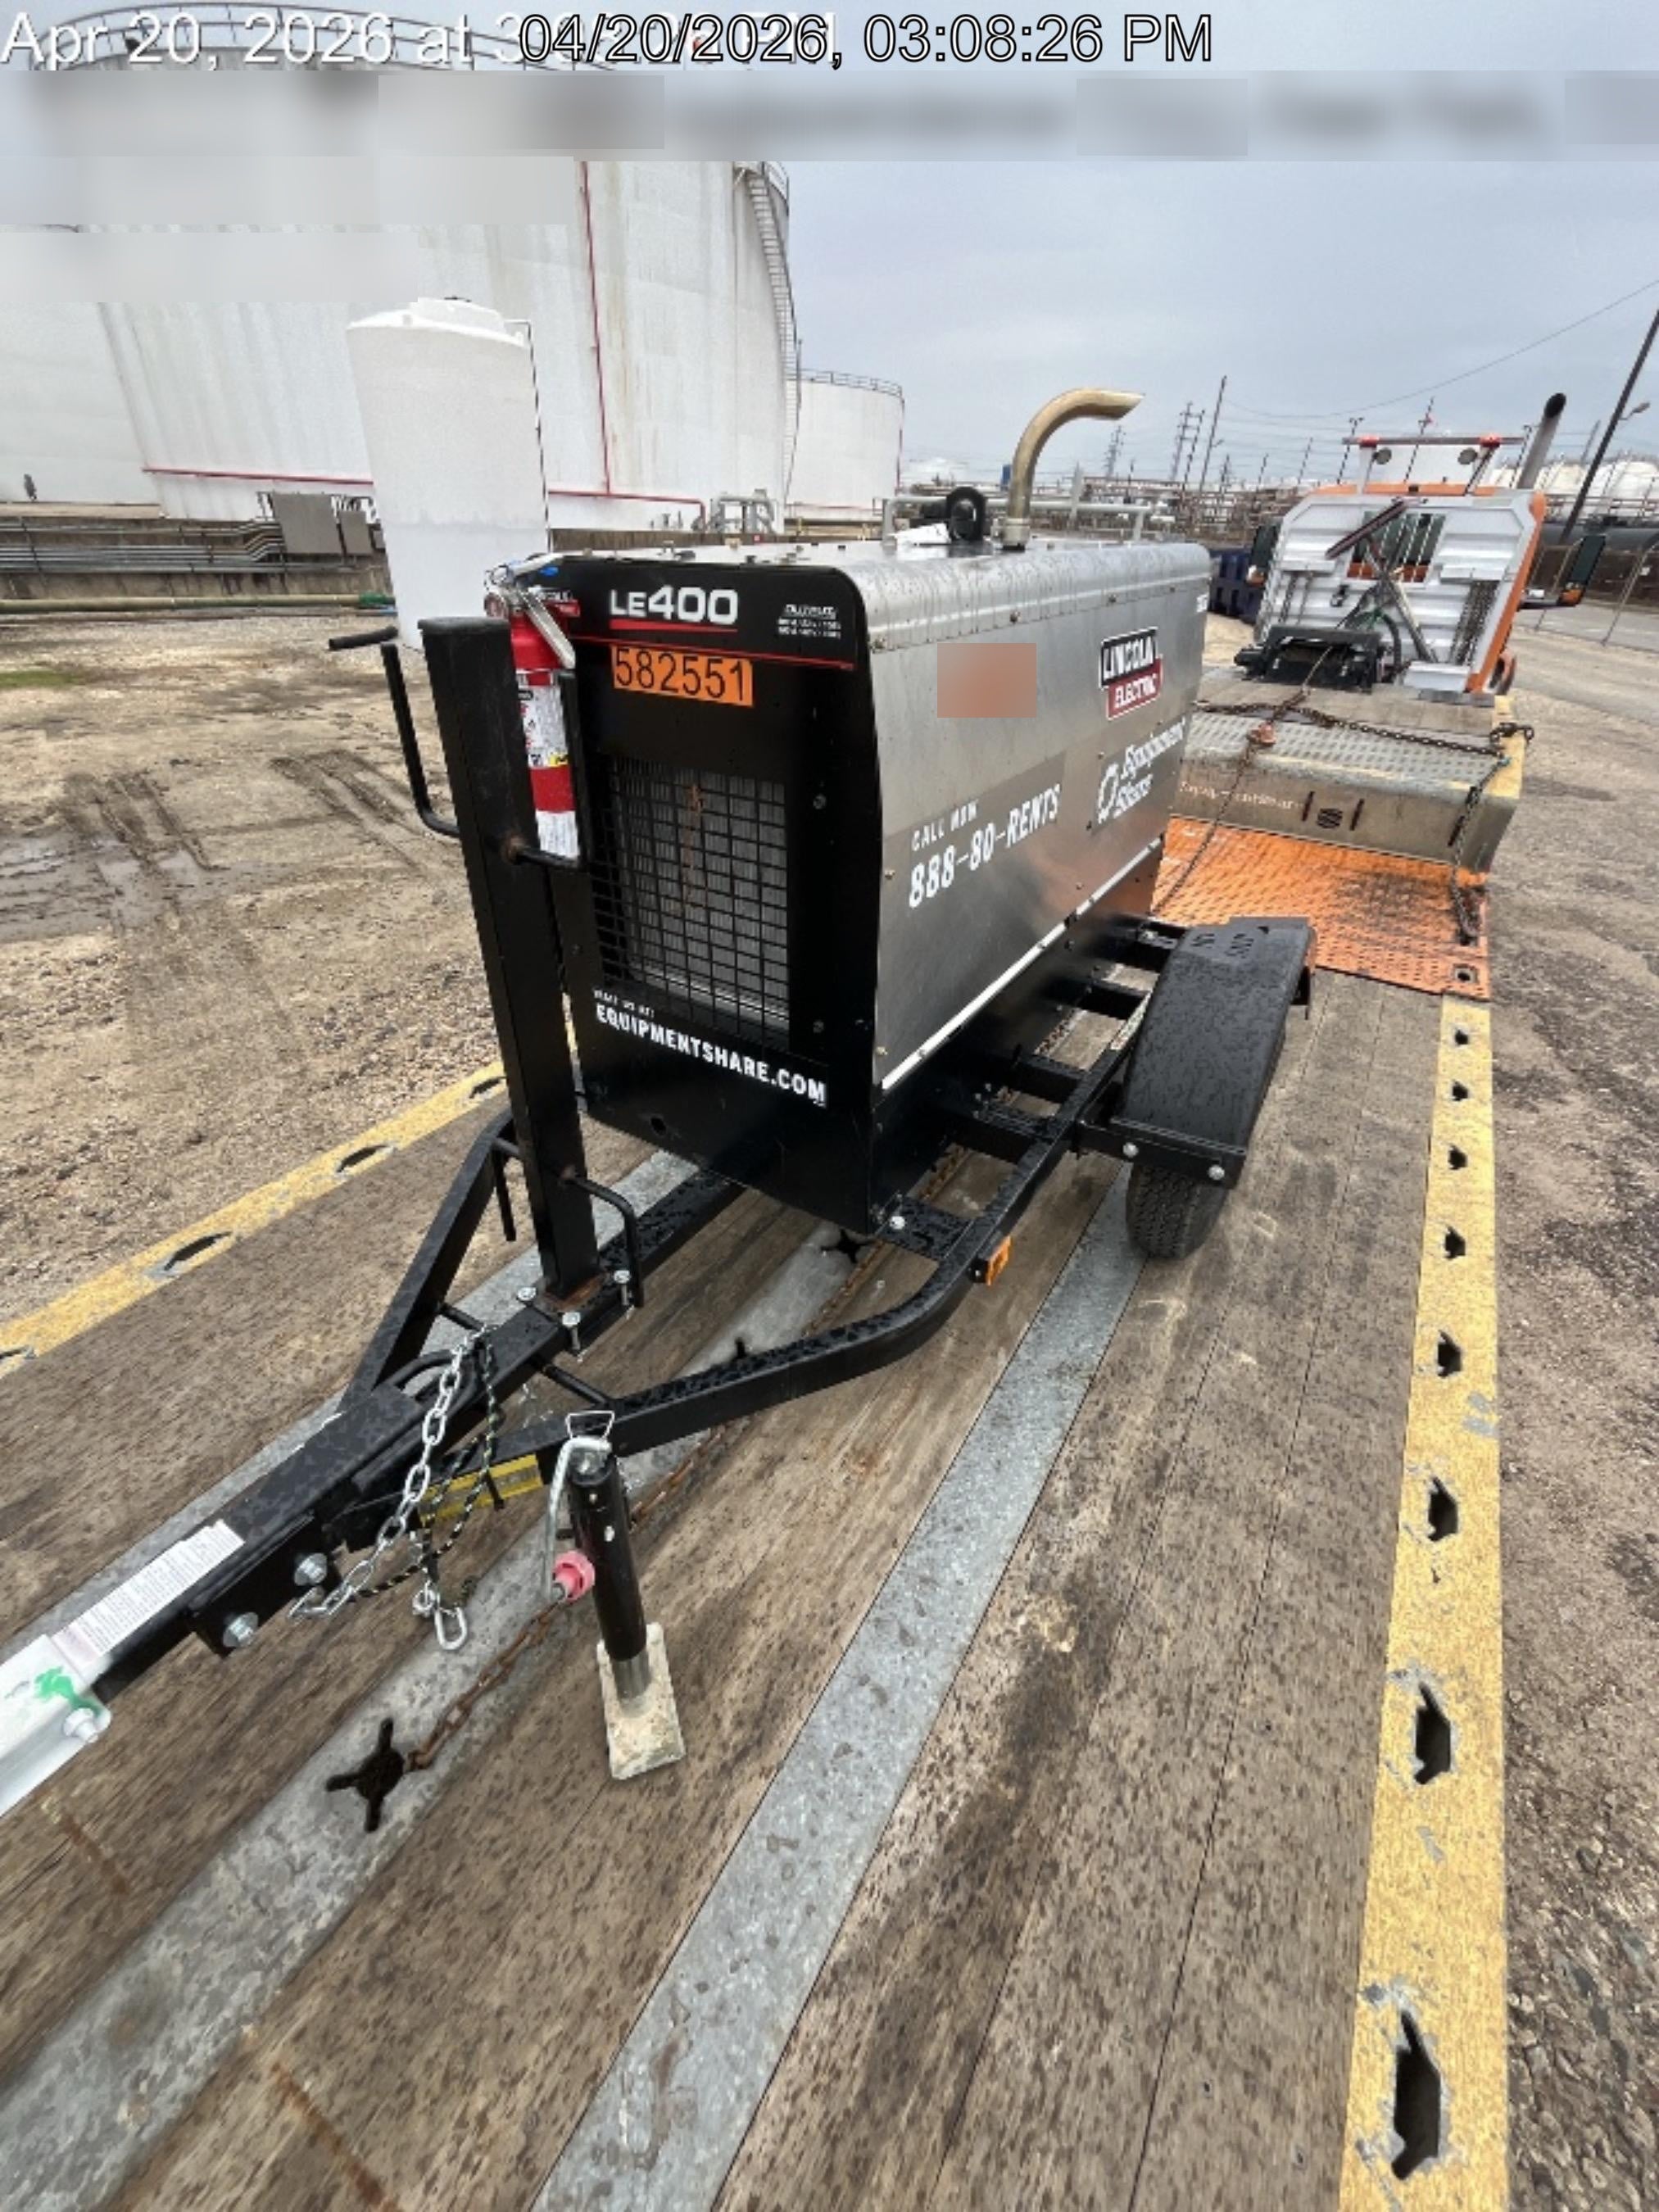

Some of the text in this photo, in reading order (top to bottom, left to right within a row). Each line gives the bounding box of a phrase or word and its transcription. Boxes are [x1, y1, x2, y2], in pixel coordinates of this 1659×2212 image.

[610, 585, 739, 625] LE400
[615, 648, 747, 701] 582551
[909, 783, 1061, 909] 888-80-RENTS
[911, 818, 945, 852] CALL
[596, 1003, 827, 1103] EQUIPMENTSHARE.COM
